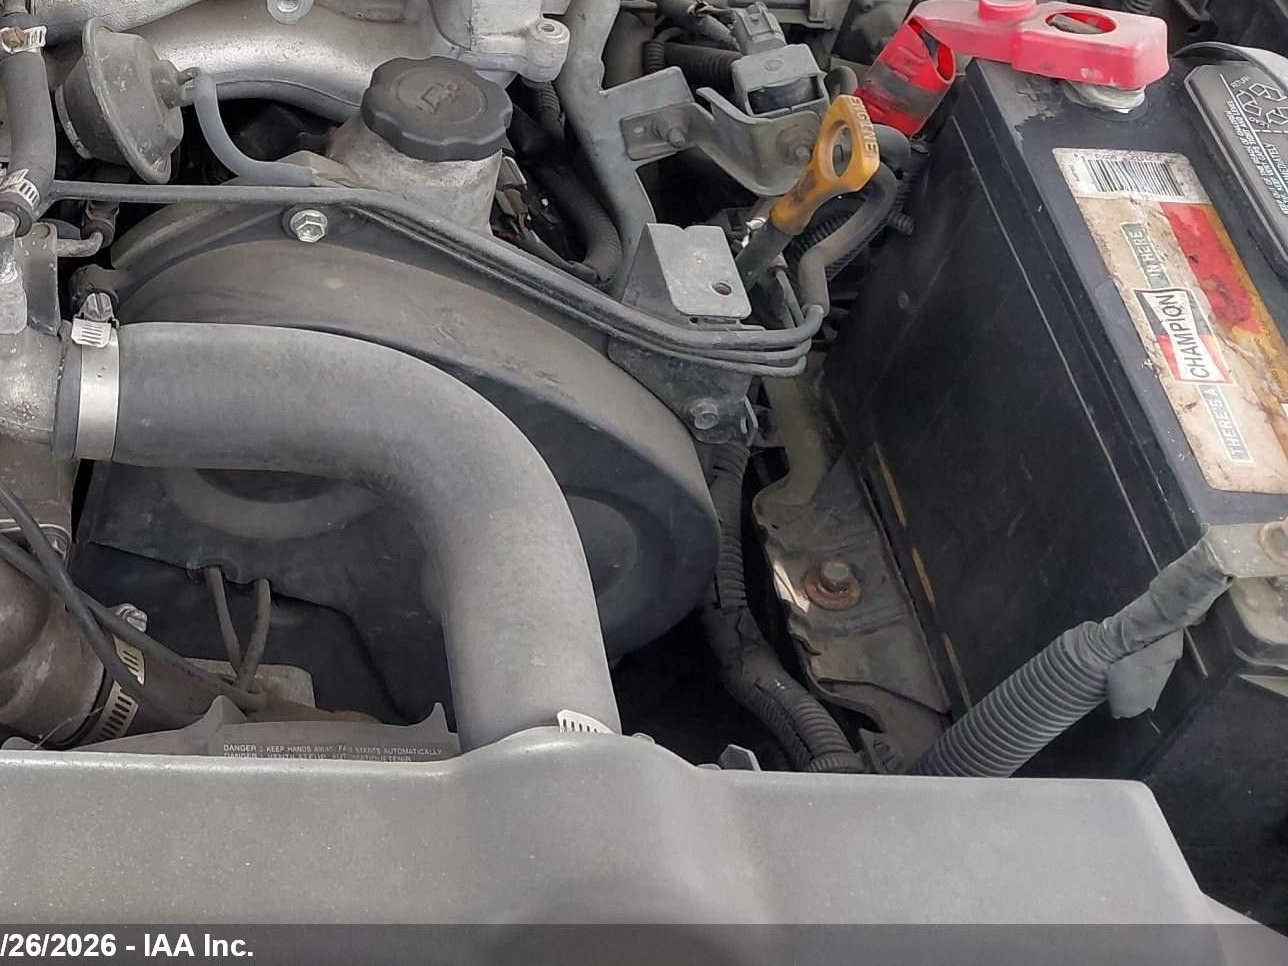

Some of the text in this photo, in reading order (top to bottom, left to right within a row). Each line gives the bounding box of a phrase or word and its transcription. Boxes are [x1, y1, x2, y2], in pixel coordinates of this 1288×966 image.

[850, 96, 879, 154] ENGINE
[1129, 227, 1244, 456] THERE'S A CHAMPION IN HERE
[223, 743, 257, 753] DANGER
[266, 744, 285, 753] KEEP
[287, 745, 312, 754] HANDS
[383, 746, 442, 756] AUTOMATICALLY
